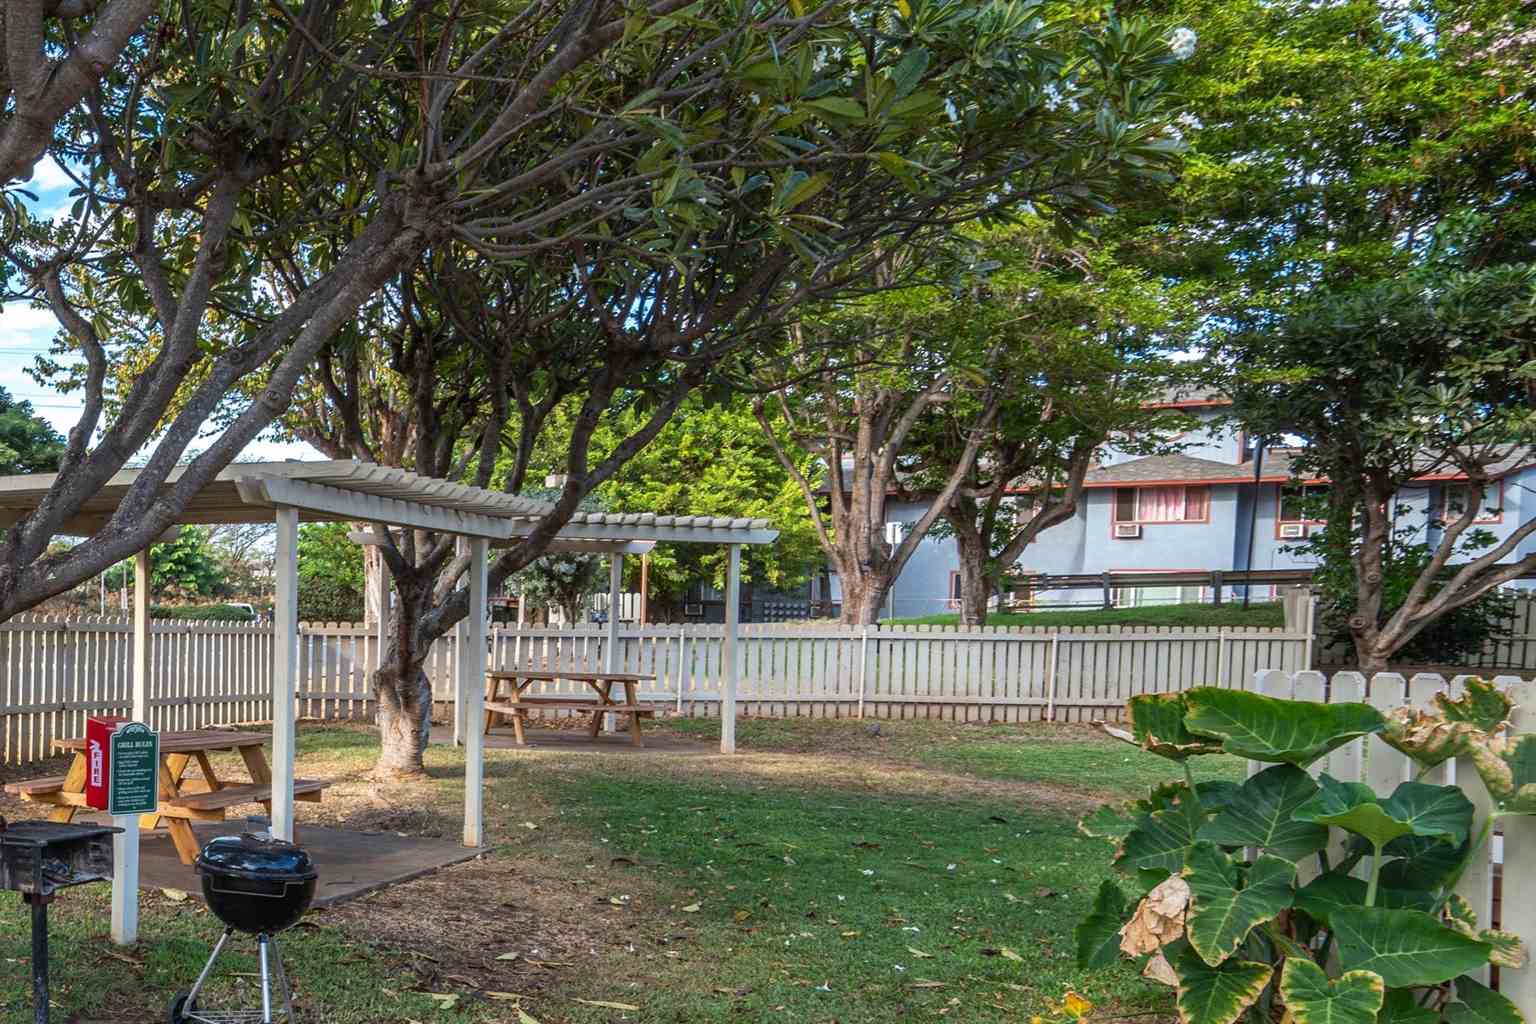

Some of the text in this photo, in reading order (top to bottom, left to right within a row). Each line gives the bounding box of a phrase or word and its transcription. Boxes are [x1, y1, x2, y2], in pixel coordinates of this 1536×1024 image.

[117, 740, 153, 749] GRILL RULES
[93, 751, 101, 784] FIRE
